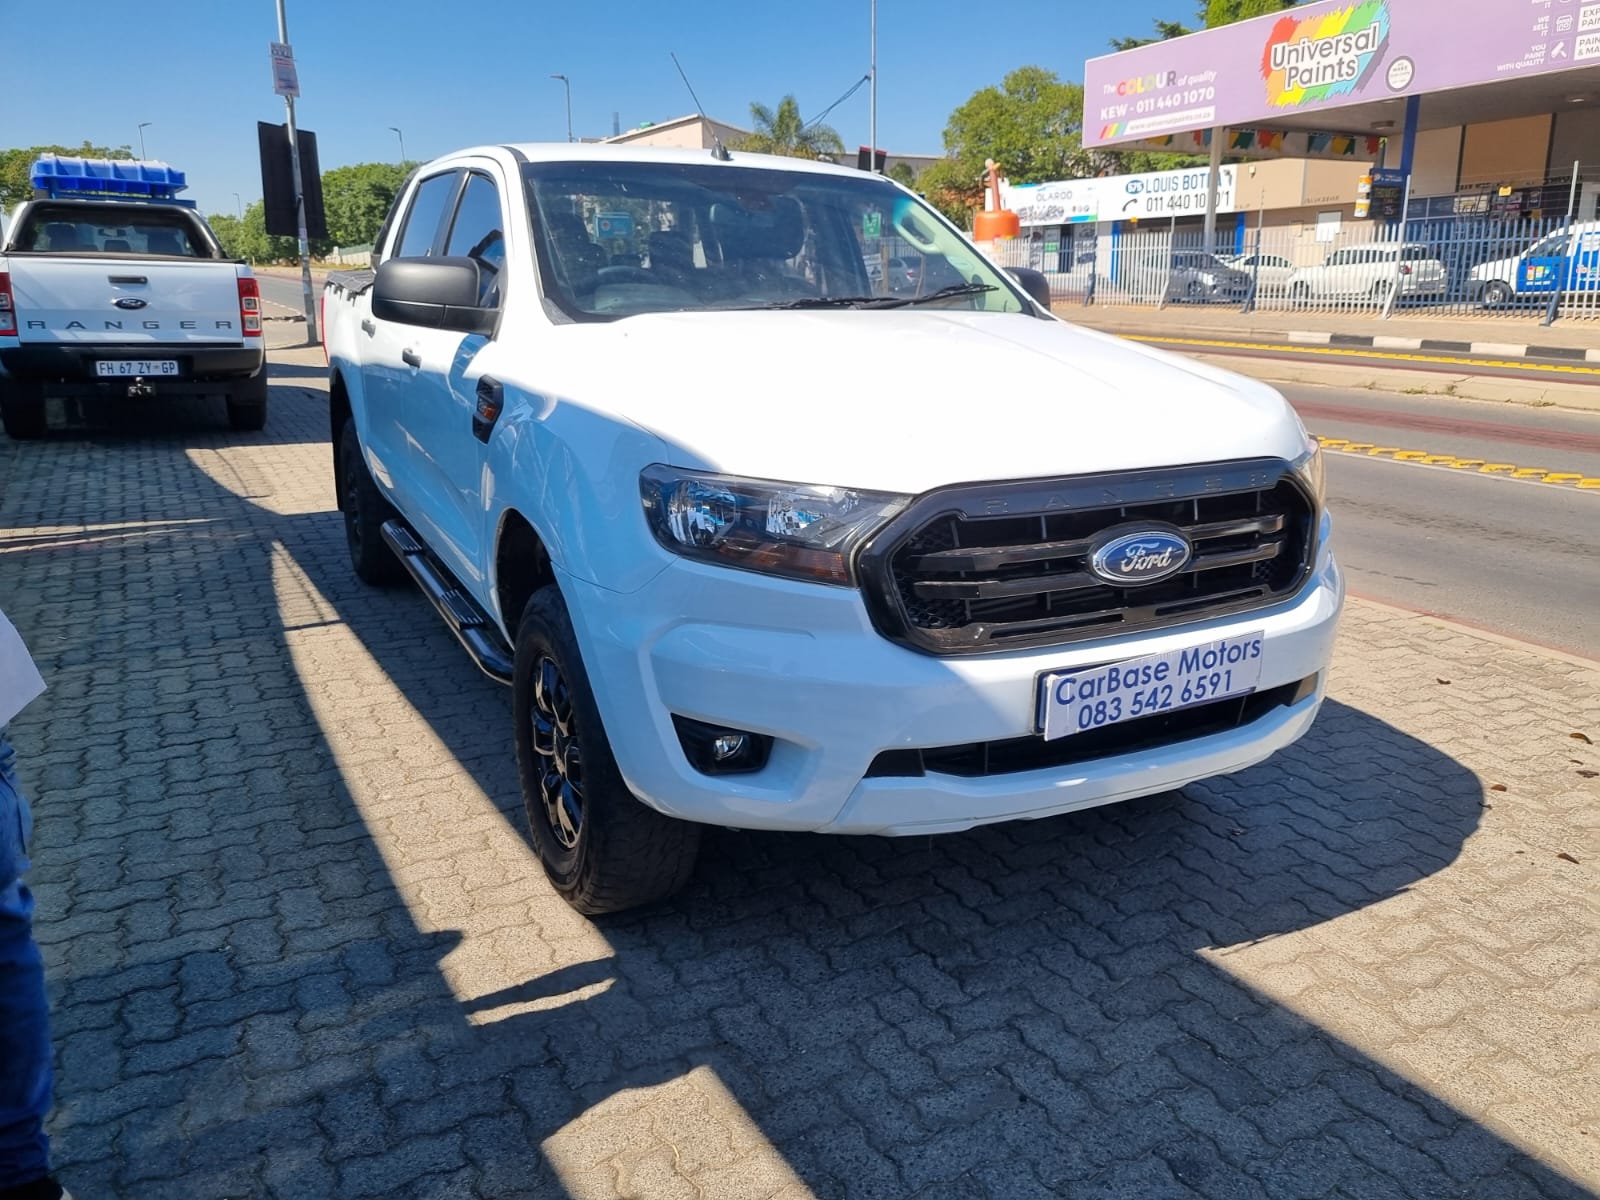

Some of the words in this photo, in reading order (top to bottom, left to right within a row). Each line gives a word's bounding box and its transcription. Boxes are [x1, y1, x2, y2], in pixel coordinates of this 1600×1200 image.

[1273, 26, 1377, 67] Universal
[1531, 43, 1546, 52] YOU
[1103, 83, 1116, 95] The
[1117, 70, 1176, 96] COLOUR
[1177, 75, 1187, 86] of
[1188, 71, 1217, 86] quality
[1287, 57, 1356, 88] Paints
[1101, 104, 1128, 120] KEW
[1136, 98, 1154, 113] 011
[1157, 93, 1181, 109] 440
[1184, 87, 1215, 105] 1070
[1145, 176, 1178, 194] LOUIS
[1146, 197, 1163, 212] 011
[1167, 195, 1190, 211] 440
[27, 321, 232, 330] RANGER
[100, 363, 114, 375] FH
[119, 362, 132, 374] 67
[138, 362, 151, 374] ZY
[161, 361, 176, 373] GP
[1120, 541, 1173, 573] Ford
[1055, 661, 1170, 706] CarBase
[1178, 637, 1261, 676] Motors
[1078, 694, 1122, 729] 083
[1130, 682, 1173, 716] 542
[1180, 669, 1232, 703] 6591
